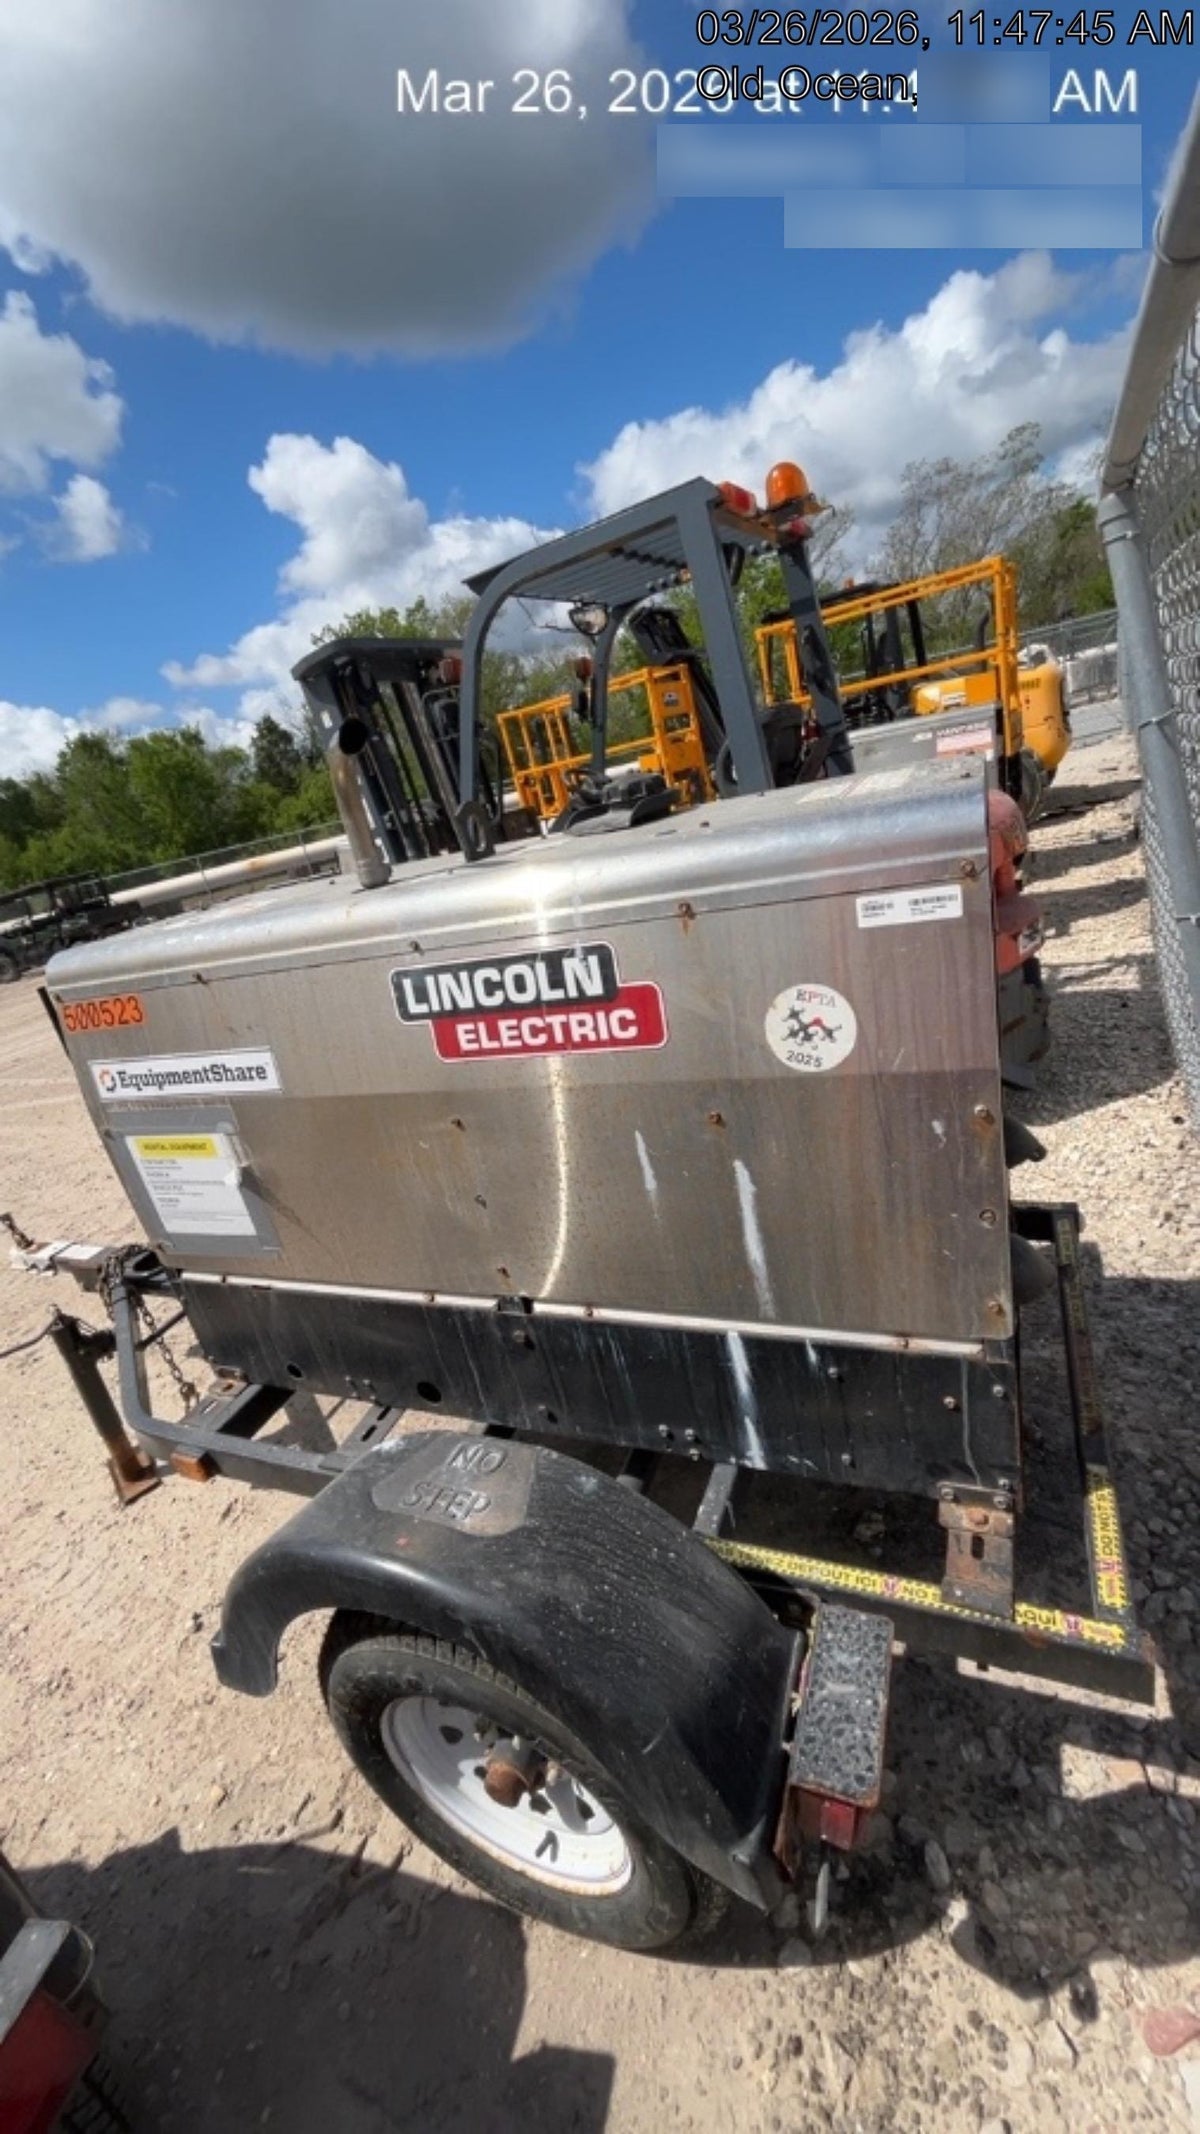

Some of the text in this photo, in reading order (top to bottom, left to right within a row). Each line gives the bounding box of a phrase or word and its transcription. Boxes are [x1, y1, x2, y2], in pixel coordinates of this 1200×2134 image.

[402, 954, 604, 1014] LINCOLN
[64, 996, 143, 1031] 500523
[455, 1008, 638, 1051] ELECTRIC
[116, 1063, 268, 1091] EquipmentShare
[446, 1440, 509, 1475] NO
[402, 1480, 493, 1522] STEP
